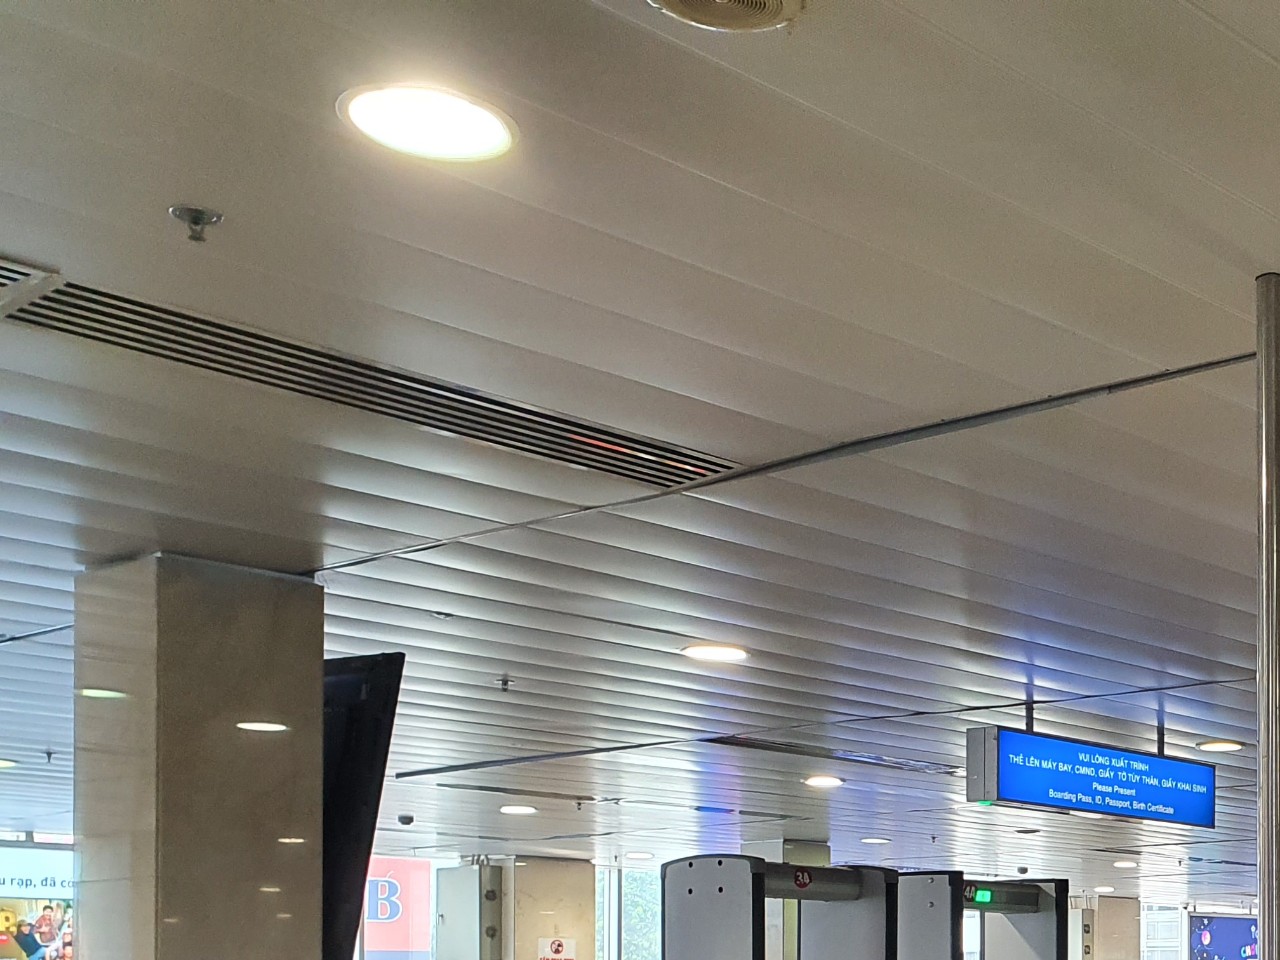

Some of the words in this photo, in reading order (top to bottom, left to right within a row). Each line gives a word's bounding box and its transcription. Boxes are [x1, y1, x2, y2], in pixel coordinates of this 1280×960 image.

[1078, 752, 1090, 763] VUI
[1091, 754, 1110, 765] LÒNG
[1111, 756, 1128, 768] XUẤT
[1130, 760, 1149, 771] TRÌNH
[1025, 756, 1040, 767] LÊN
[1041, 759, 1057, 770] MÁY
[1177, 781, 1192, 791] KHAI
[1192, 784, 1207, 794] SINH
[1092, 781, 1113, 793] Please
[1113, 785, 1136, 797] Present
[1048, 788, 1076, 803] Boarding
[1077, 793, 1094, 804] Pass,
[1105, 797, 1131, 810] Passport,
[1132, 800, 1146, 811] Birth
[1147, 803, 1175, 815] Certificate
